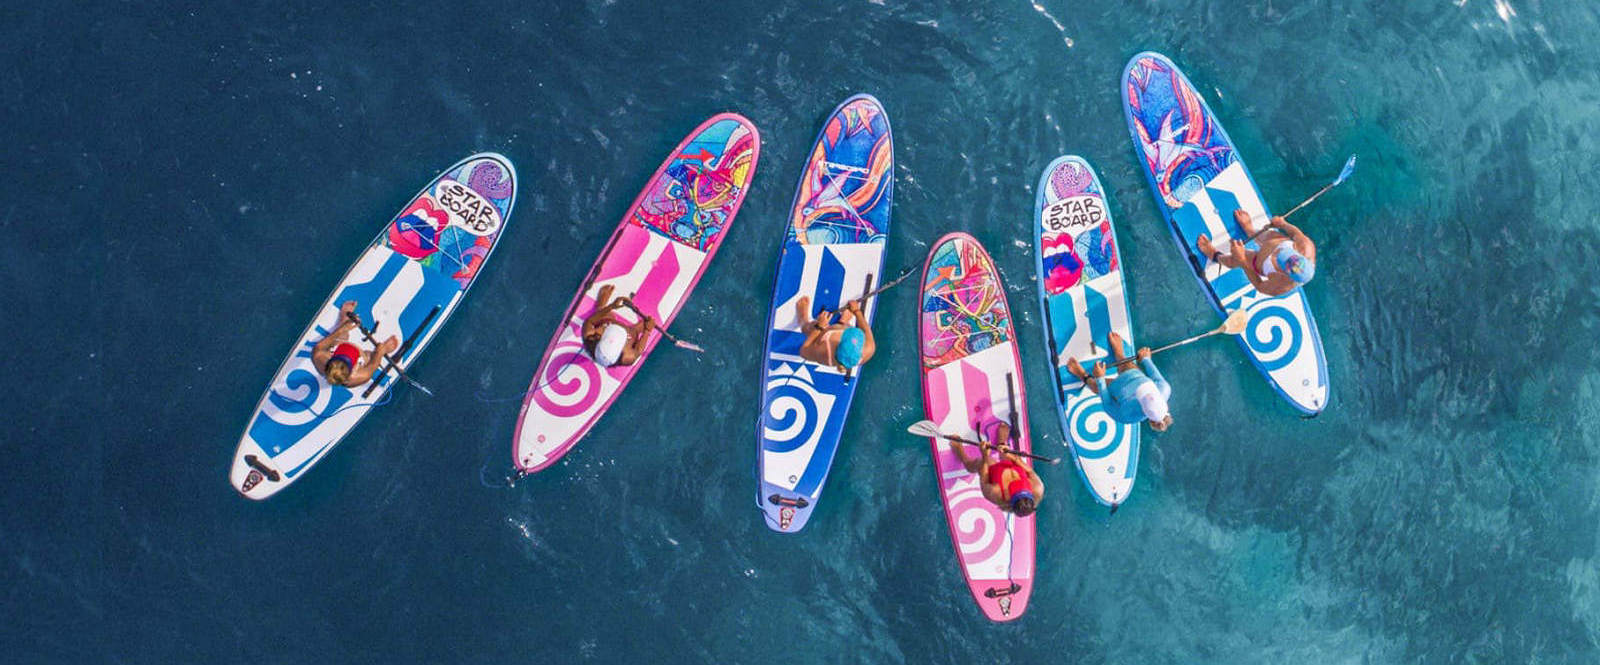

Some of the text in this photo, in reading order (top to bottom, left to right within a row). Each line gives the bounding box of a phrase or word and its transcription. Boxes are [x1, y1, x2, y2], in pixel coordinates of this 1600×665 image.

[440, 191, 488, 232] BOARD
[449, 185, 493, 221] STAR
[1050, 198, 1101, 217] STAR
[1050, 211, 1100, 231] BOARD
